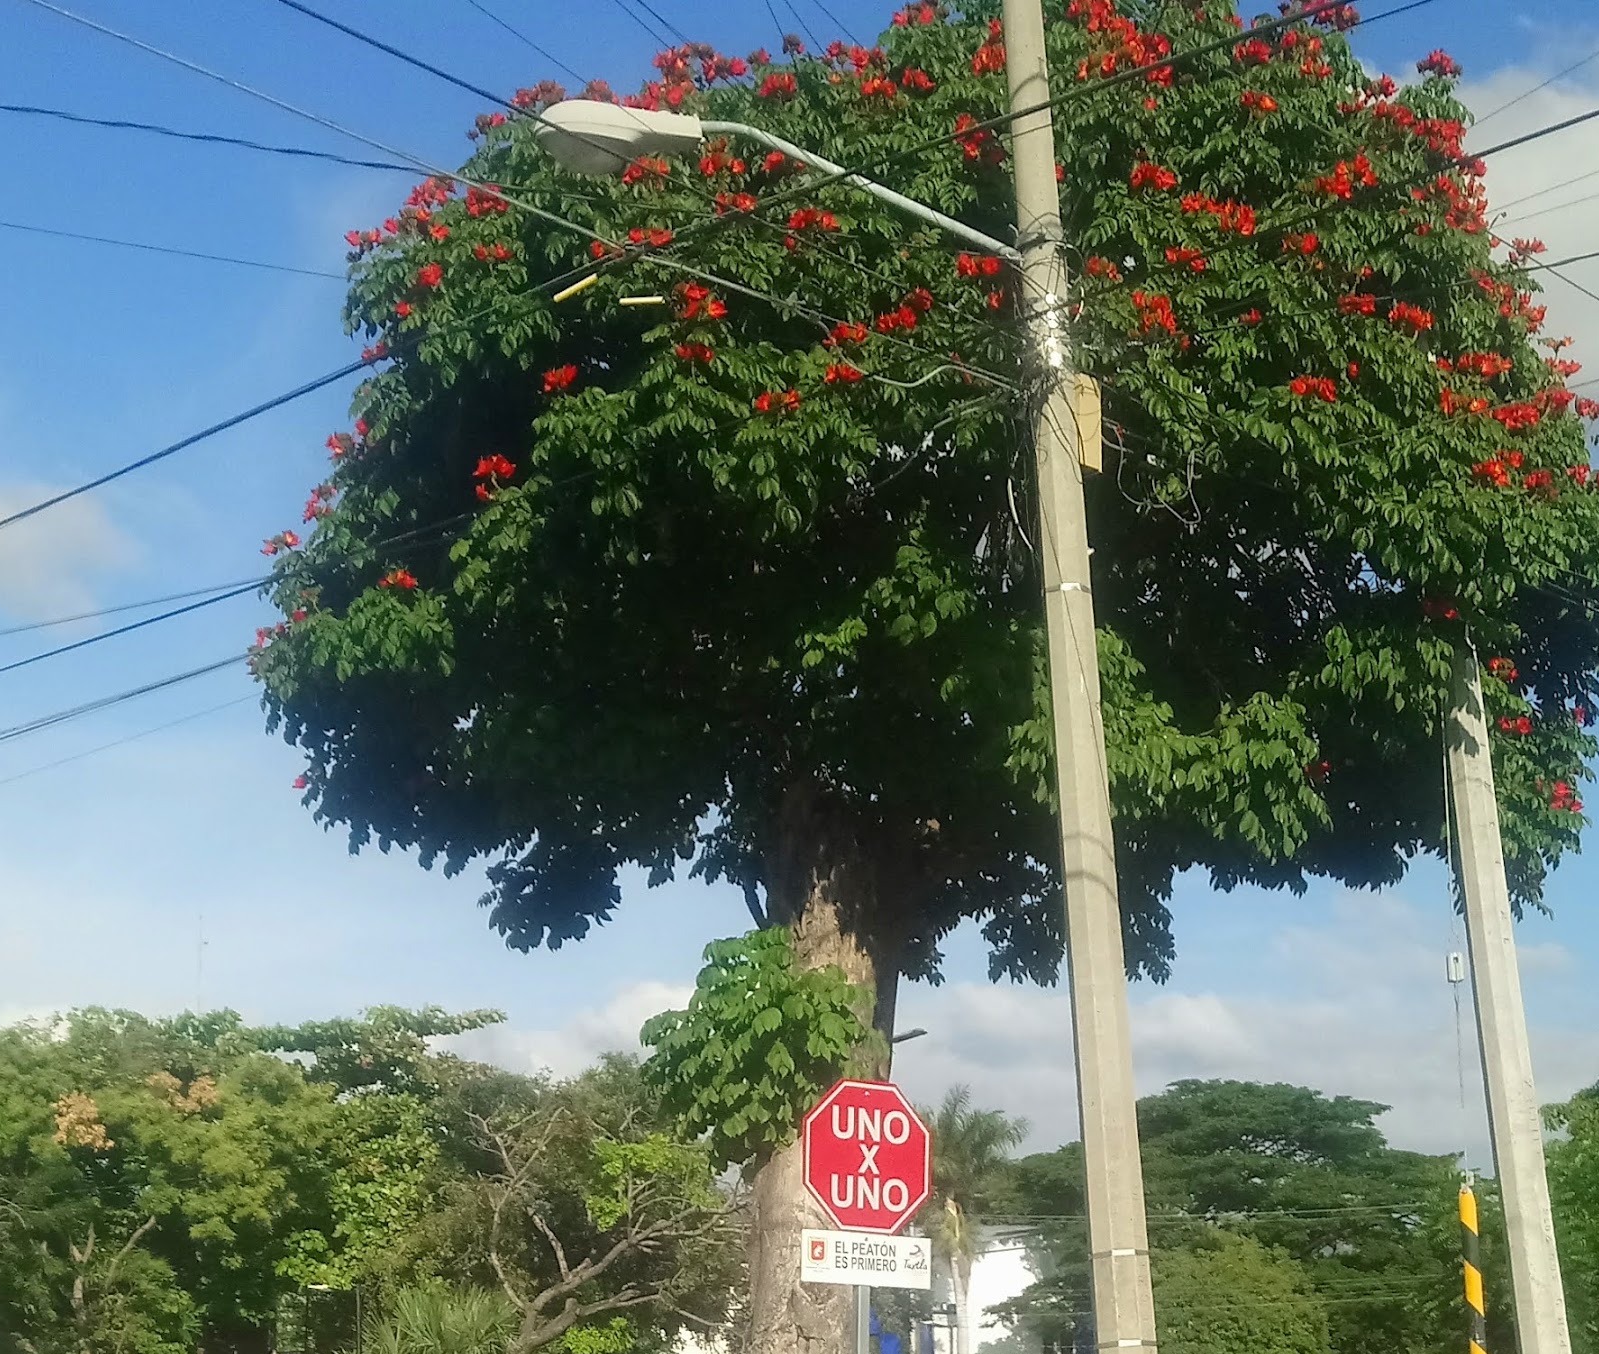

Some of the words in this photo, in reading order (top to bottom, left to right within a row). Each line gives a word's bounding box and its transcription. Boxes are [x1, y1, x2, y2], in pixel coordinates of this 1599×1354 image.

[832, 1104, 910, 1145] UNO
[858, 1143, 880, 1175] X
[831, 1173, 909, 1212] UNO
[835, 1241, 849, 1254] EL
[852, 1241, 896, 1257] PEATÓN
[835, 1255, 848, 1269] ES
[851, 1257, 897, 1272] PRIMERO
[903, 1258, 928, 1270] Tuxtla
